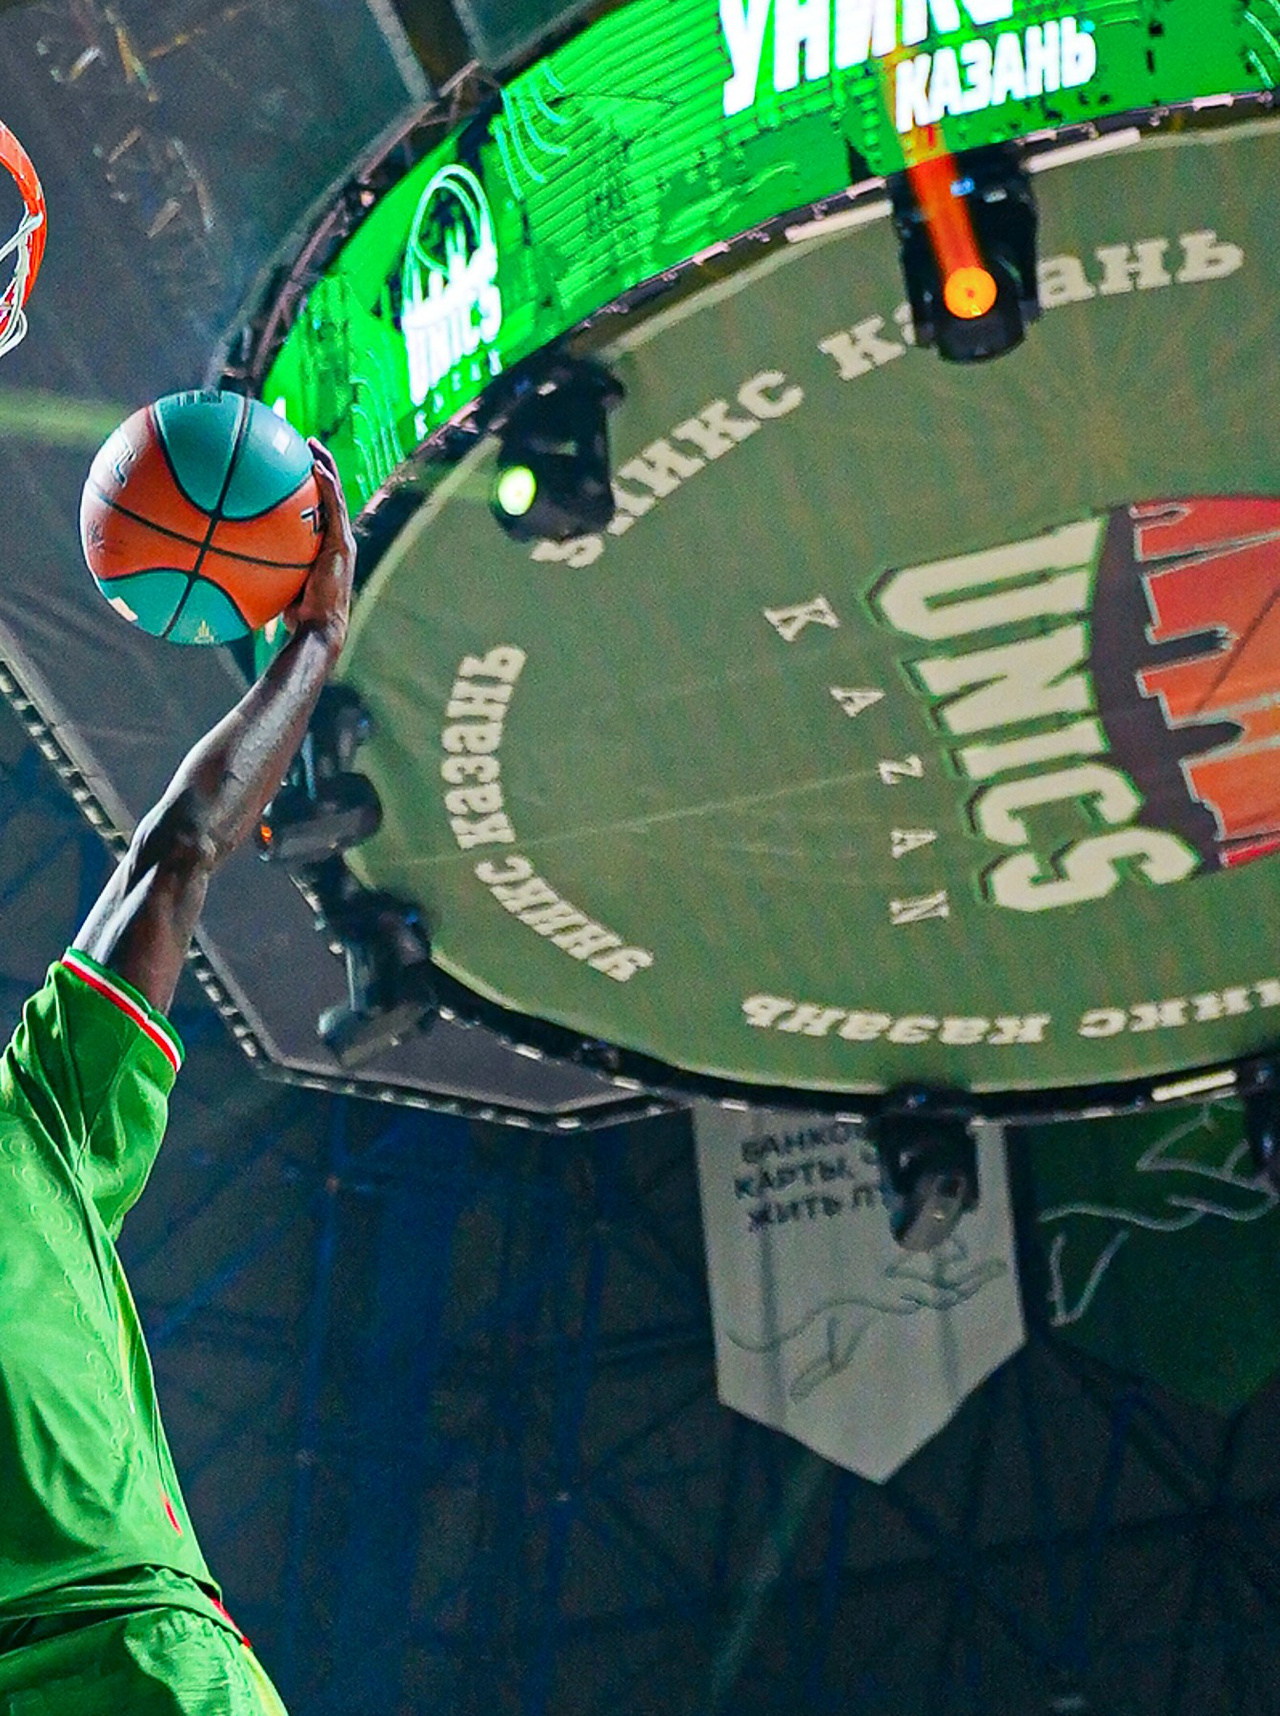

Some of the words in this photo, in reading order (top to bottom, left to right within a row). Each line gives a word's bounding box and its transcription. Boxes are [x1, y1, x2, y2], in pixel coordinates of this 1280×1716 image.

[720, 0, 1015, 117] УНИ
[895, 16, 1097, 133] КАЗАНЬ
[818, 229, 1244, 382] кань
[876, 516, 1201, 913] UNICS
